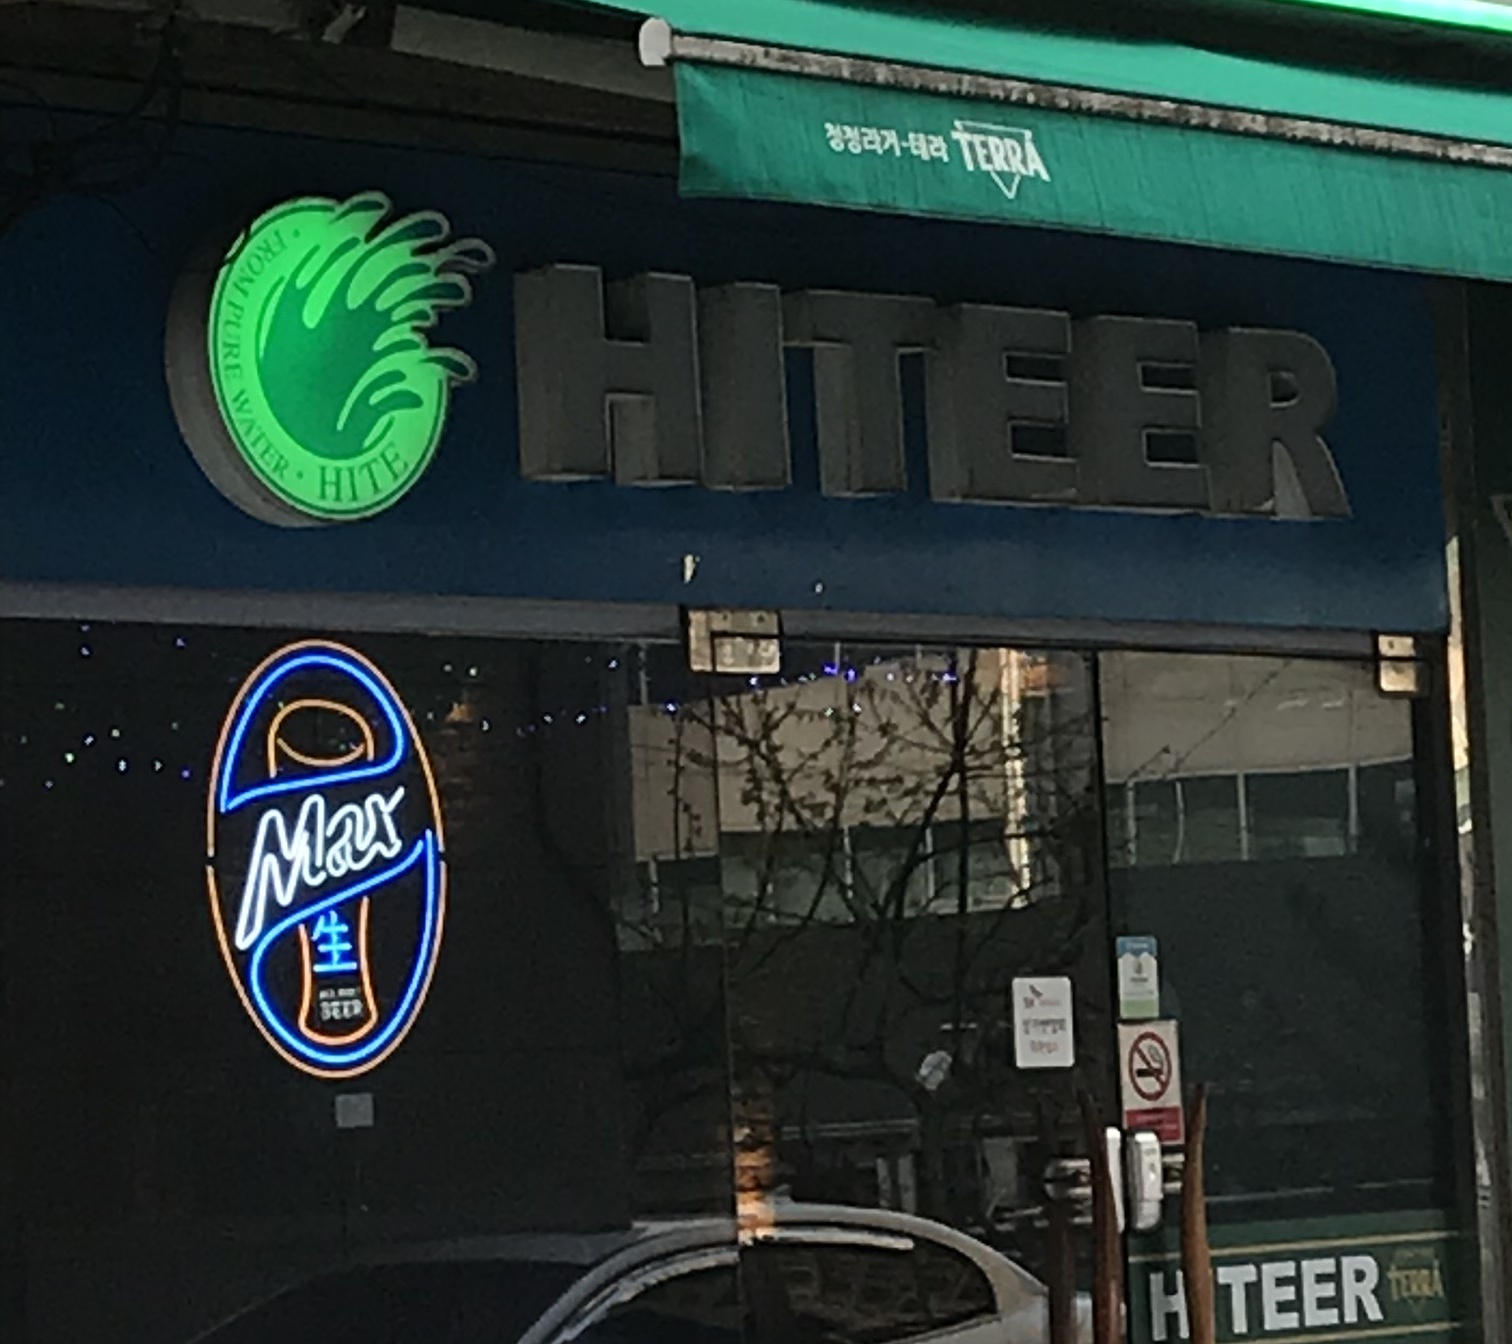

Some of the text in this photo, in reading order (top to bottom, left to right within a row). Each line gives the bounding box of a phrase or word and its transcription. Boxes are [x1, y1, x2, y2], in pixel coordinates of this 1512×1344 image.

[824, 122, 1051, 182] 청정라거-테라 TERRA
[513, 262, 1352, 522] HITEER
[231, 391, 290, 480] WATER
[318, 441, 409, 503] HITE
[235, 786, 405, 951] Max
[311, 908, 358, 973] 生
[1150, 1254, 1384, 1342] HTEER
